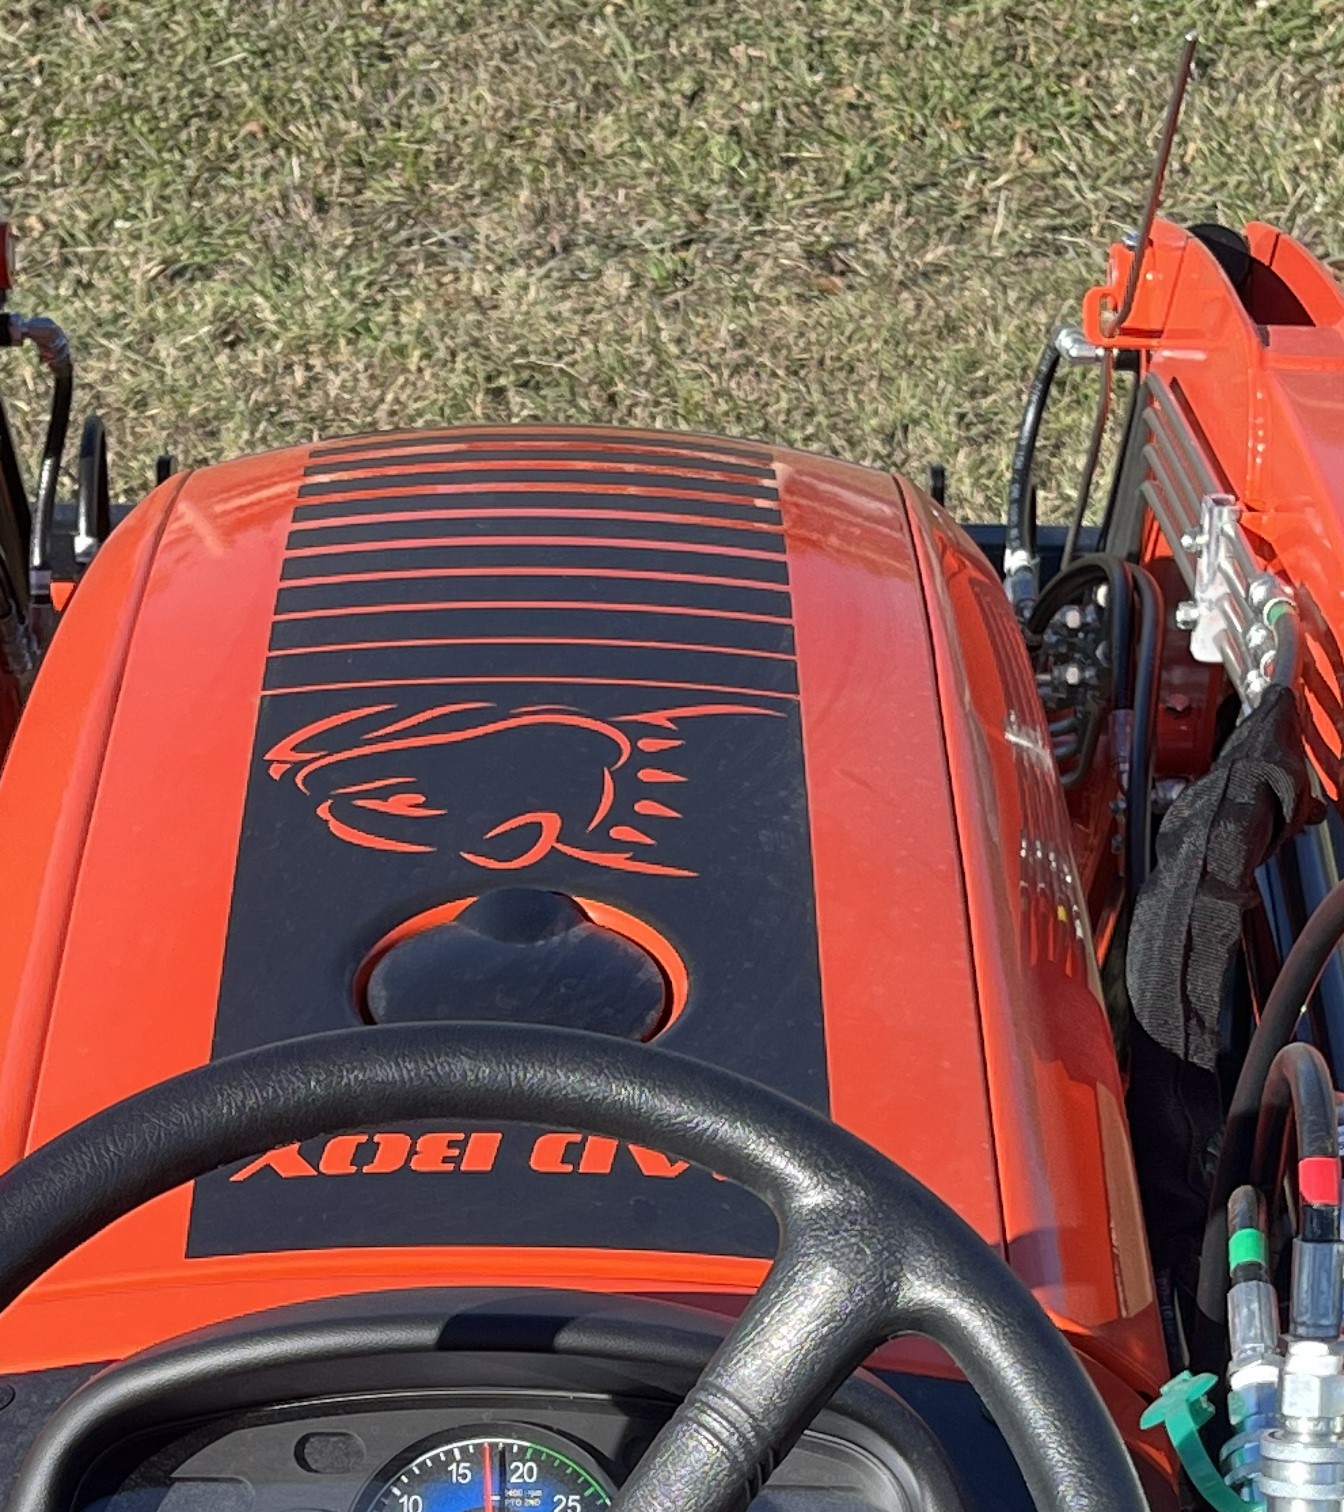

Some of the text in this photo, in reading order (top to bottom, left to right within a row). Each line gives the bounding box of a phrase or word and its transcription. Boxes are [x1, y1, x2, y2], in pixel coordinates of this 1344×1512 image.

[231, 1131, 729, 1181] AD BOY
[448, 1463, 471, 1484] 15
[510, 1463, 537, 1483] 20
